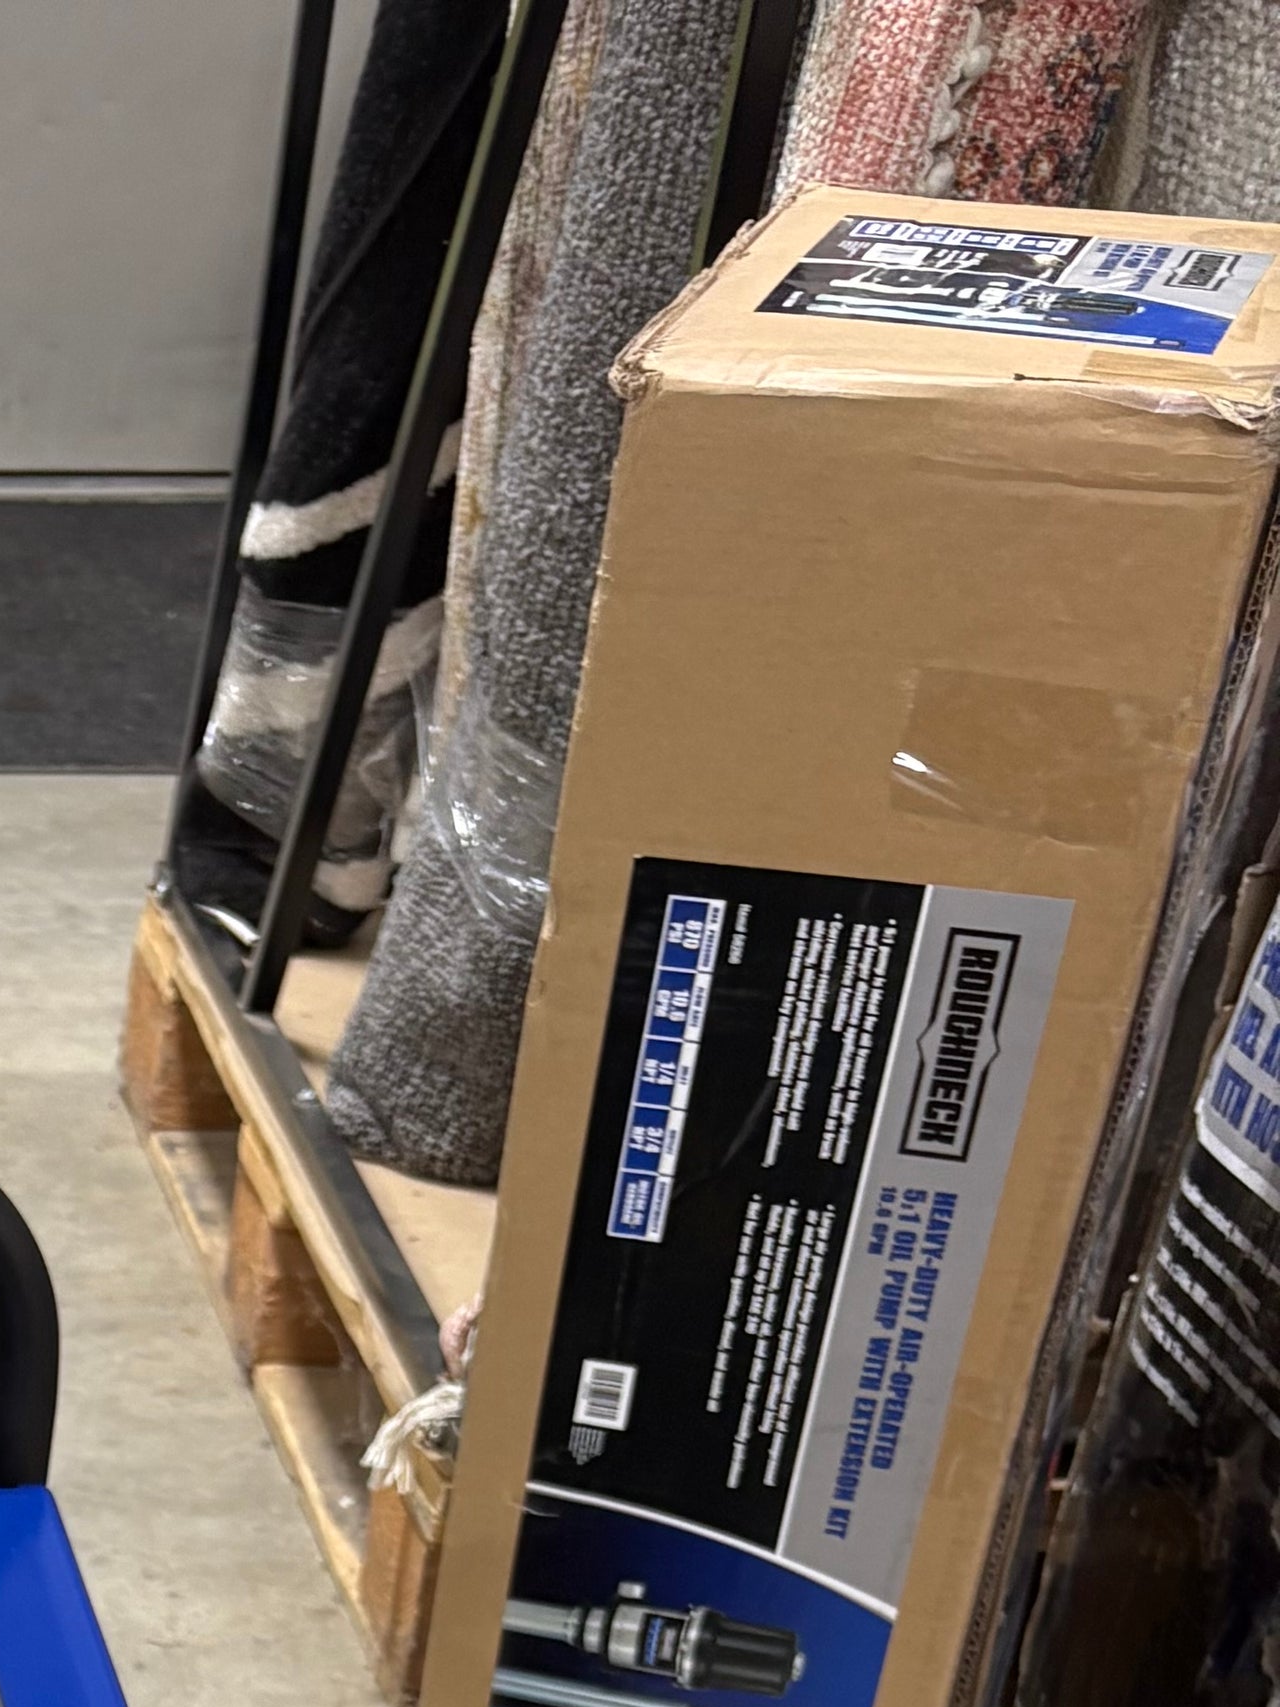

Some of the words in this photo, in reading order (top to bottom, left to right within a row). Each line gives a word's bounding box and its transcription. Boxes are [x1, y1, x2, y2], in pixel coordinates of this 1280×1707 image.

[918, 947, 1000, 1146] ROUGHNECK
[889, 1230, 916, 1260] OIL
[906, 1192, 957, 1321] HEAVY-DUTY
[875, 1270, 907, 1329] PUMP
[858, 1337, 891, 1390] WITH
[871, 1327, 923, 1469] AIR-OPERATED
[834, 1397, 877, 1500] EXTENSION
[825, 1507, 850, 1538] KIT
